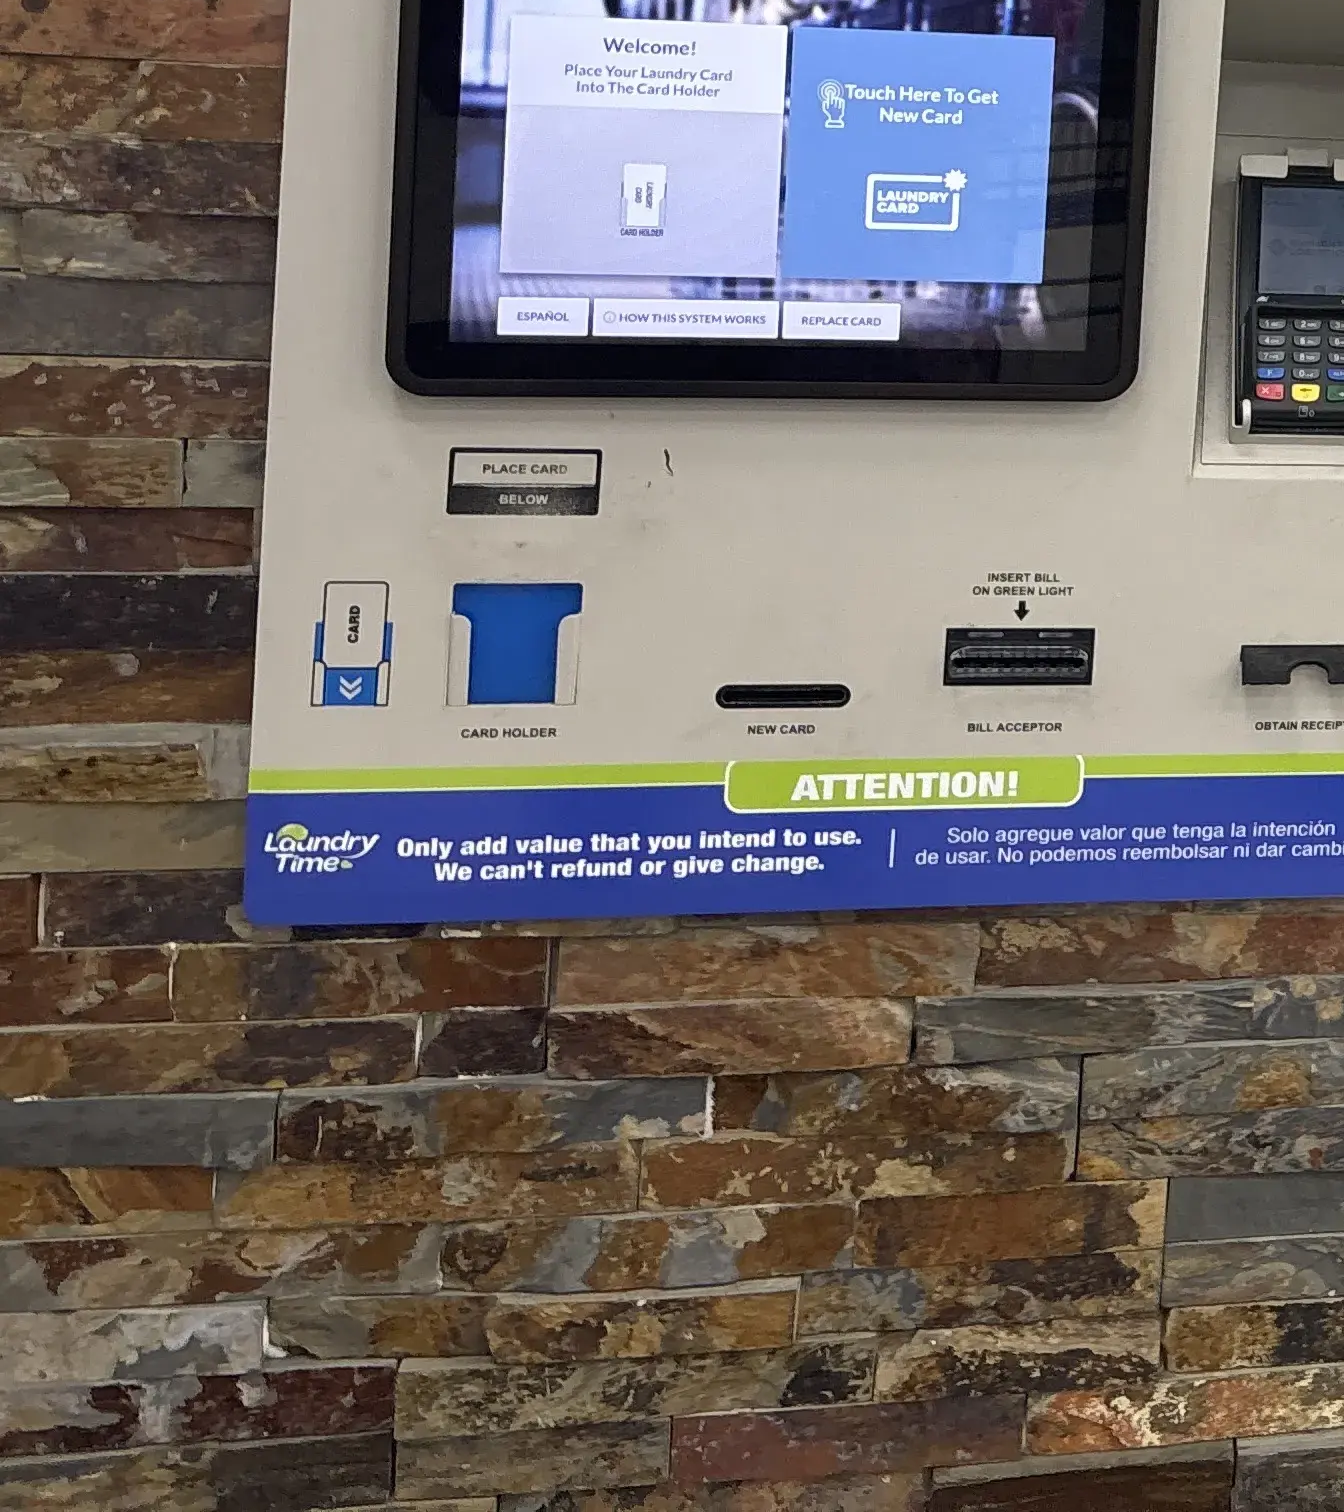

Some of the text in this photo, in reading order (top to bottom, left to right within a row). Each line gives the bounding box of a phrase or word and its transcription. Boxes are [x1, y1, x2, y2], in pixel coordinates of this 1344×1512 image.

[603, 37, 697, 57] Welcome!
[564, 64, 732, 83] Place Your Laundry Card
[576, 81, 720, 98] Into The Card Holder
[845, 84, 998, 105] Touch Here To Get
[879, 107, 962, 125] New Card
[517, 308, 569, 323] ESPAÑOL
[483, 464, 567, 475] PLACE CARD
[499, 494, 548, 505] BELOW
[987, 573, 1060, 583] INSERT BILL
[972, 586, 1074, 596] ON GREEN LIGHT
[347, 605, 361, 644] CARD
[461, 728, 556, 738] CARD HOLDER
[791, 771, 1019, 801] ATTENTION!
[264, 829, 380, 858] Laundry
[398, 829, 862, 859] Only add value that you intend to use.
[276, 854, 342, 874] Time
[434, 852, 824, 882] We can't refund or give change.
